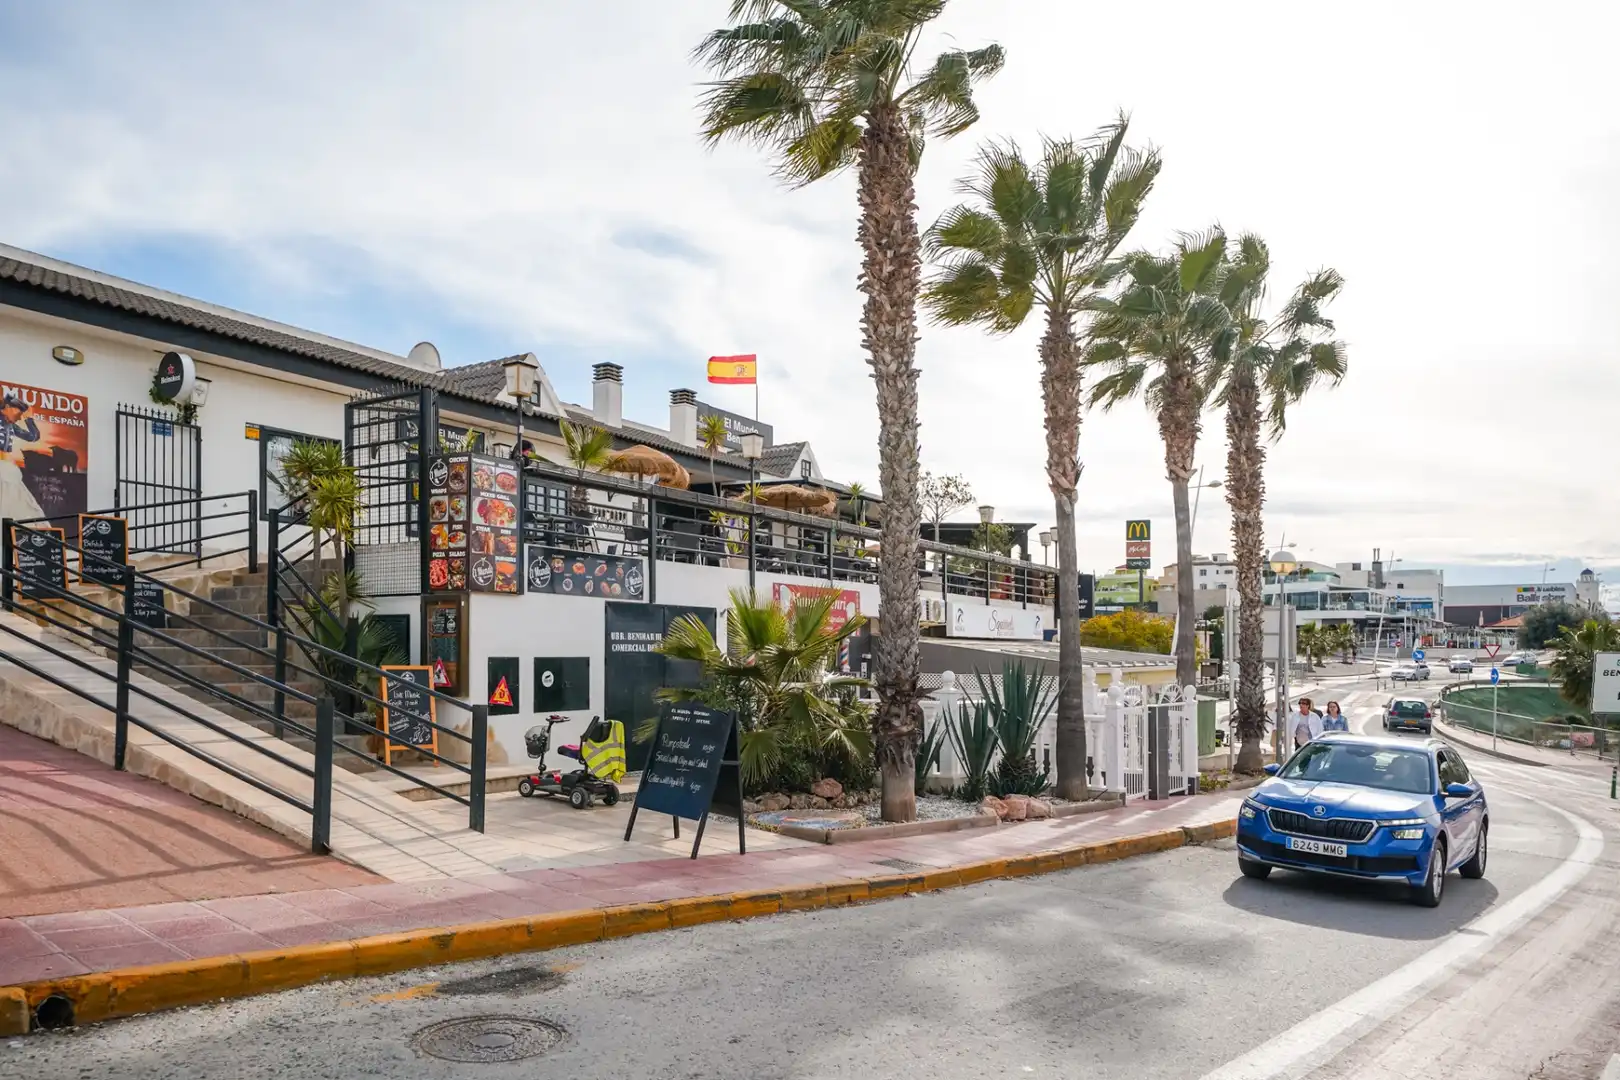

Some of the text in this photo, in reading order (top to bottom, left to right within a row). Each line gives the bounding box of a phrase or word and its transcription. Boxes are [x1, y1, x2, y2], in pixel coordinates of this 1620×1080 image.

[161, 374, 181, 384] Heineken
[1, 385, 84, 414] MUNDO
[33, 413, 85, 428] DE ESPAÑA
[723, 417, 759, 434] El Mundo
[628, 632, 654, 640] BENIMAR
[612, 644, 646, 652] COMERCIAL
[1293, 840, 1344, 856] 6249 MMG
